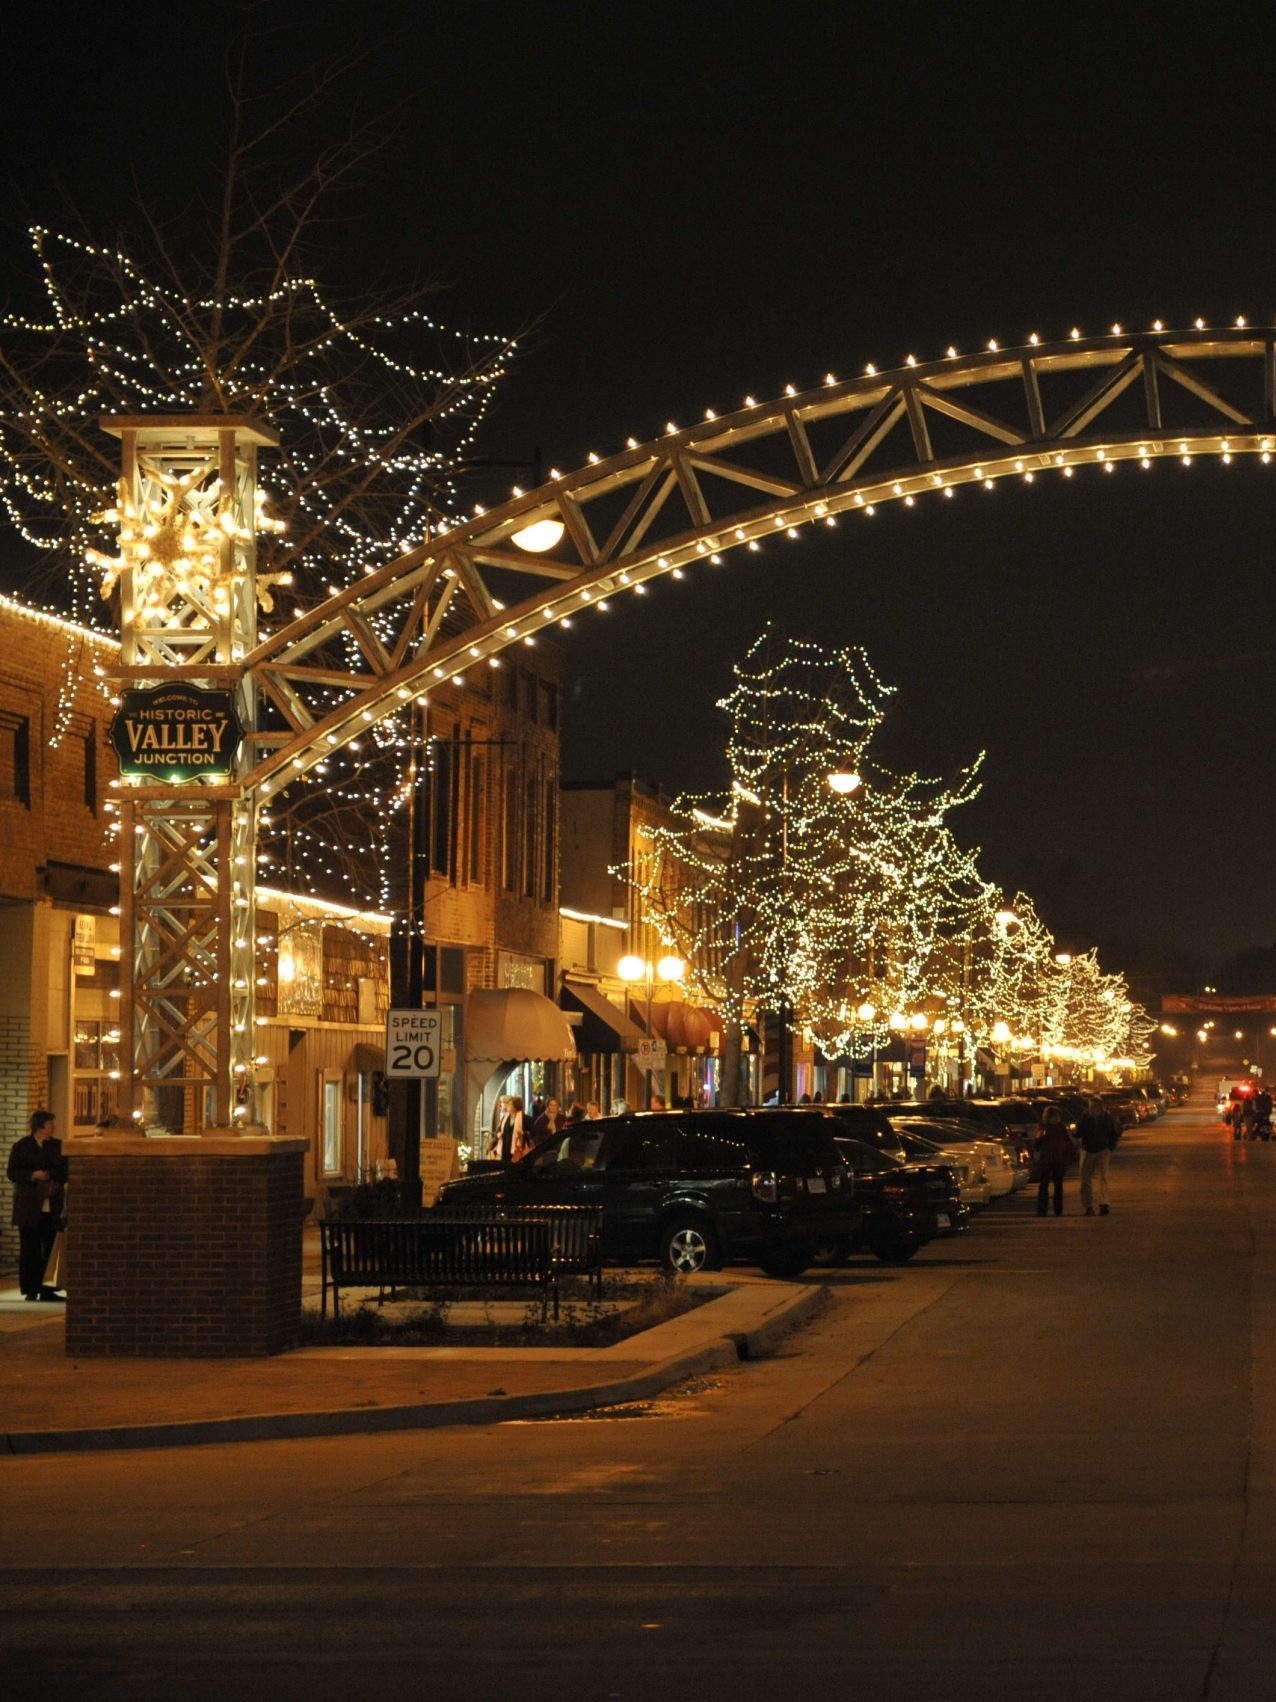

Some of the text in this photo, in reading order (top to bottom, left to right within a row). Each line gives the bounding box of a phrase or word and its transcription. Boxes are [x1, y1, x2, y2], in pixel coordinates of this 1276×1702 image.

[152, 694, 187, 704] WELCOME
[140, 709, 213, 720] HISTORIC
[125, 720, 228, 752] VALLEY
[134, 753, 215, 764] JUNCTION
[392, 1017, 437, 1028] SPEED
[396, 1032, 431, 1042] LIMIT
[392, 1045, 434, 1069] 20
